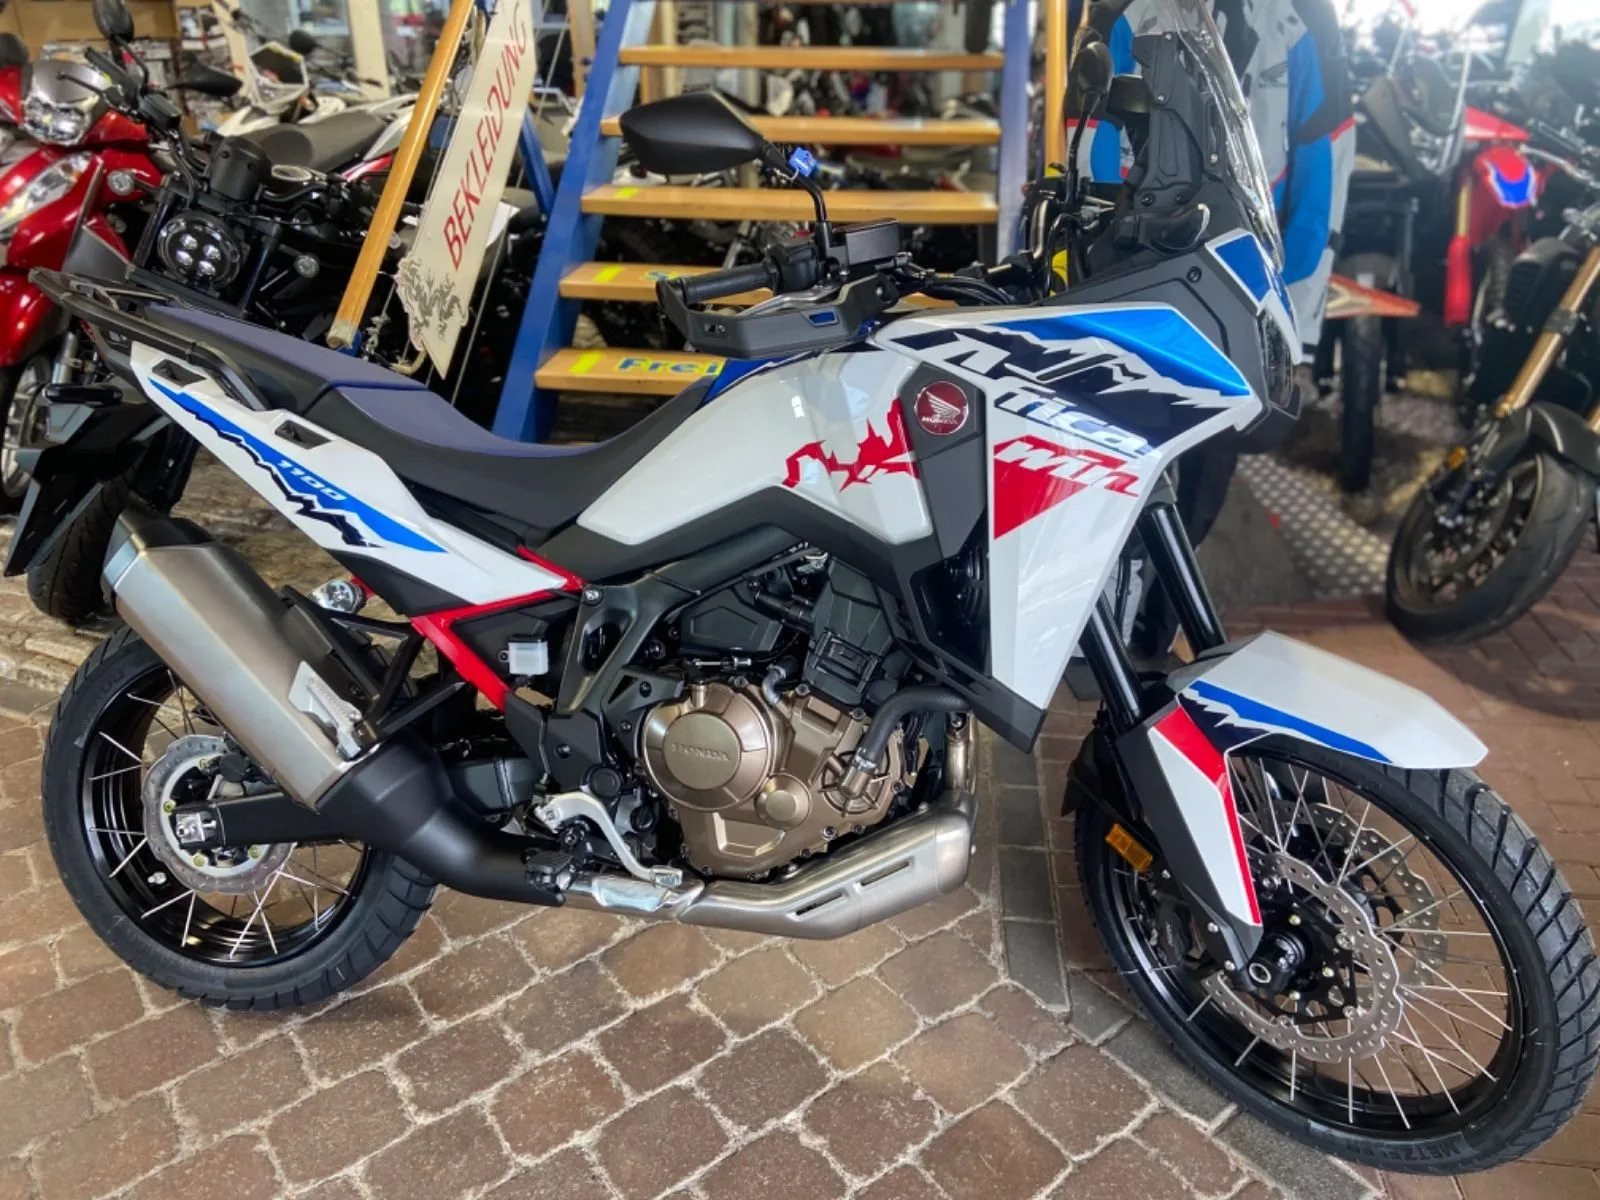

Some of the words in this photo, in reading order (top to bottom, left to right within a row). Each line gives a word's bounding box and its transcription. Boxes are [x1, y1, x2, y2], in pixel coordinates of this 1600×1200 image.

[614, 357, 722, 376] Frei
[277, 459, 348, 501] 1100
[671, 743, 733, 762] HONDA
